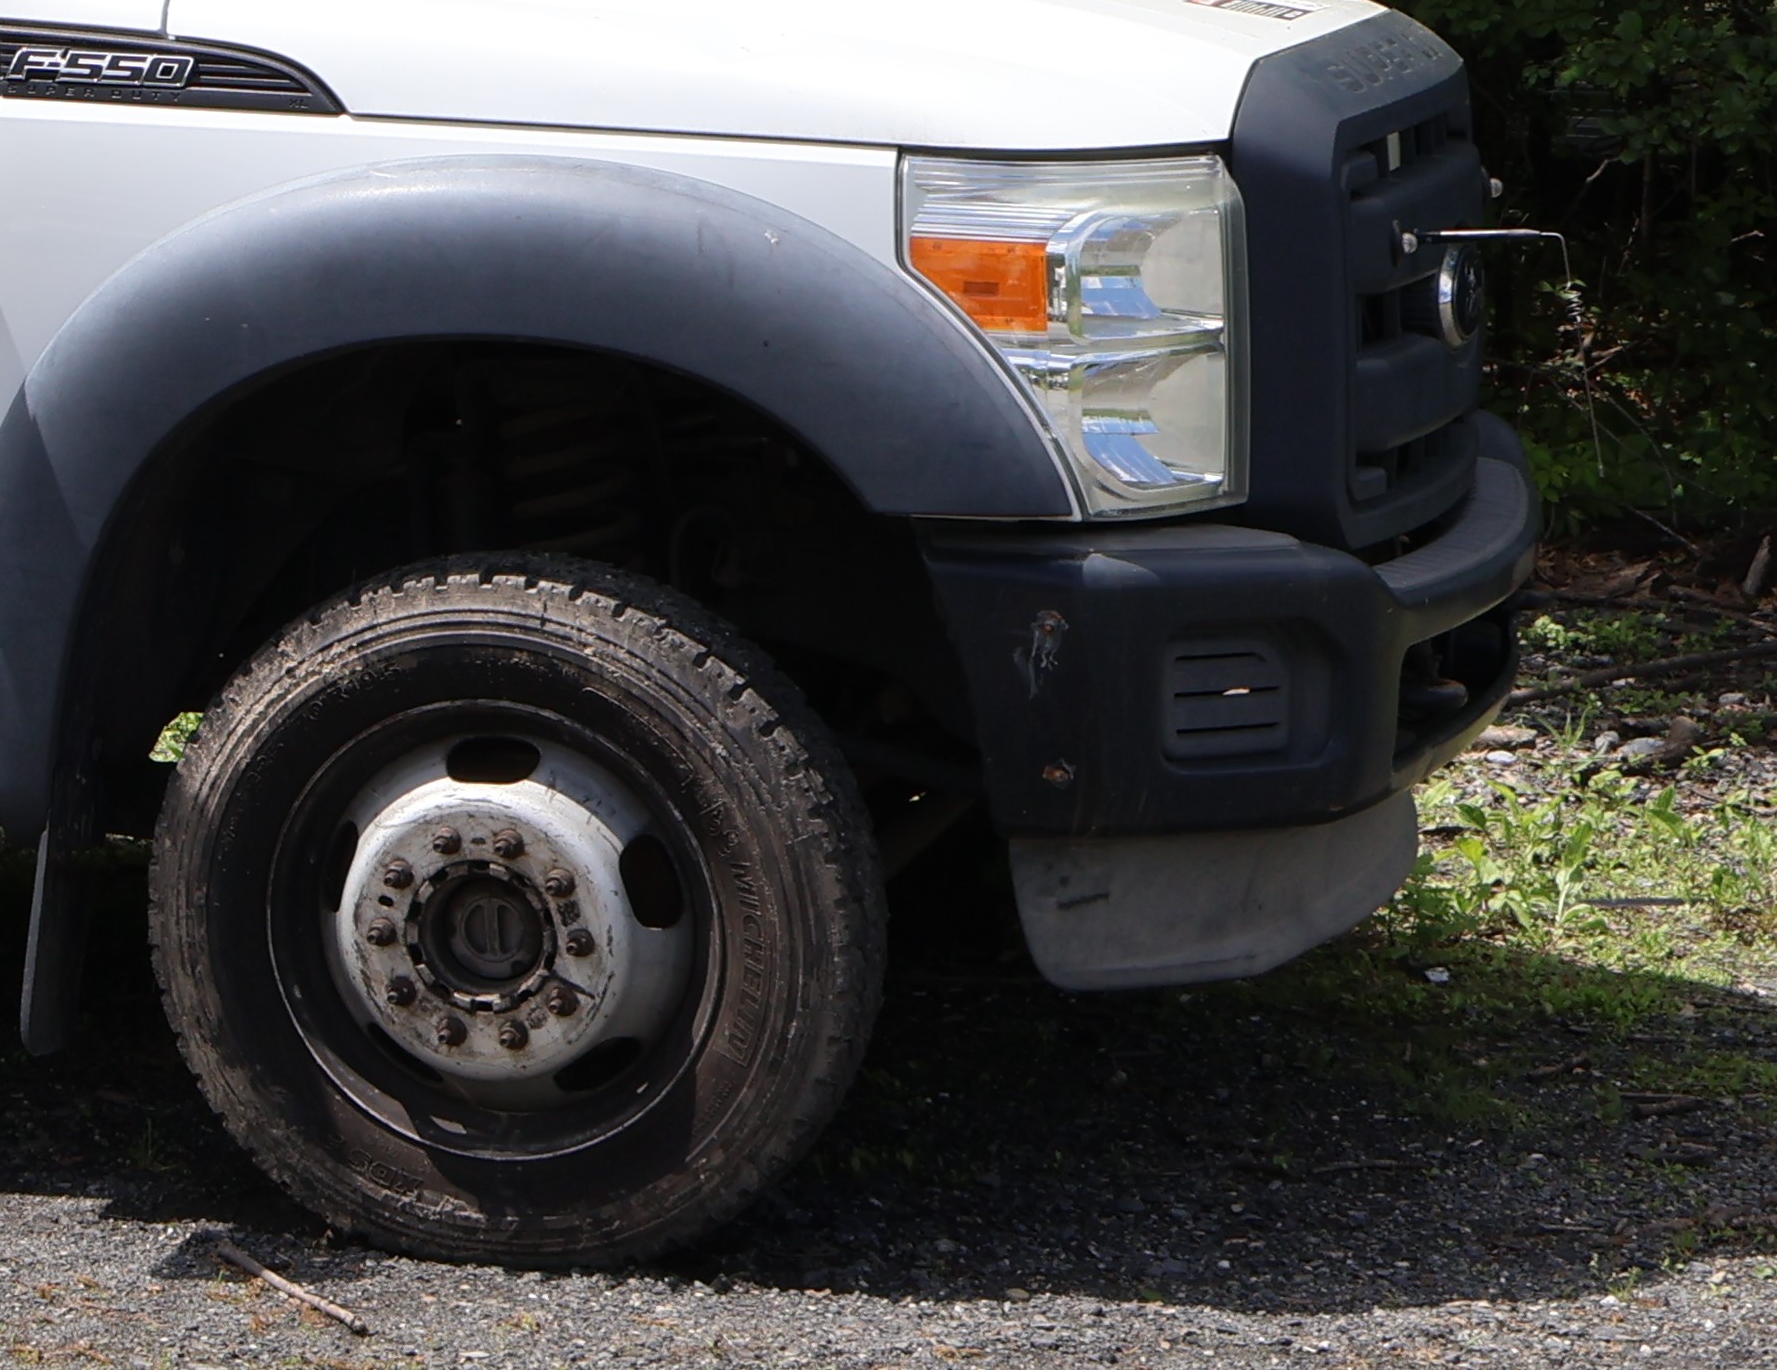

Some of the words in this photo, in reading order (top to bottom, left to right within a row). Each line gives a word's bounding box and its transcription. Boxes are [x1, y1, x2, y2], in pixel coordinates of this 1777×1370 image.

[2, 46, 197, 88] F-550
[7, 85, 96, 98] SUPER
[111, 90, 183, 103] DUTY
